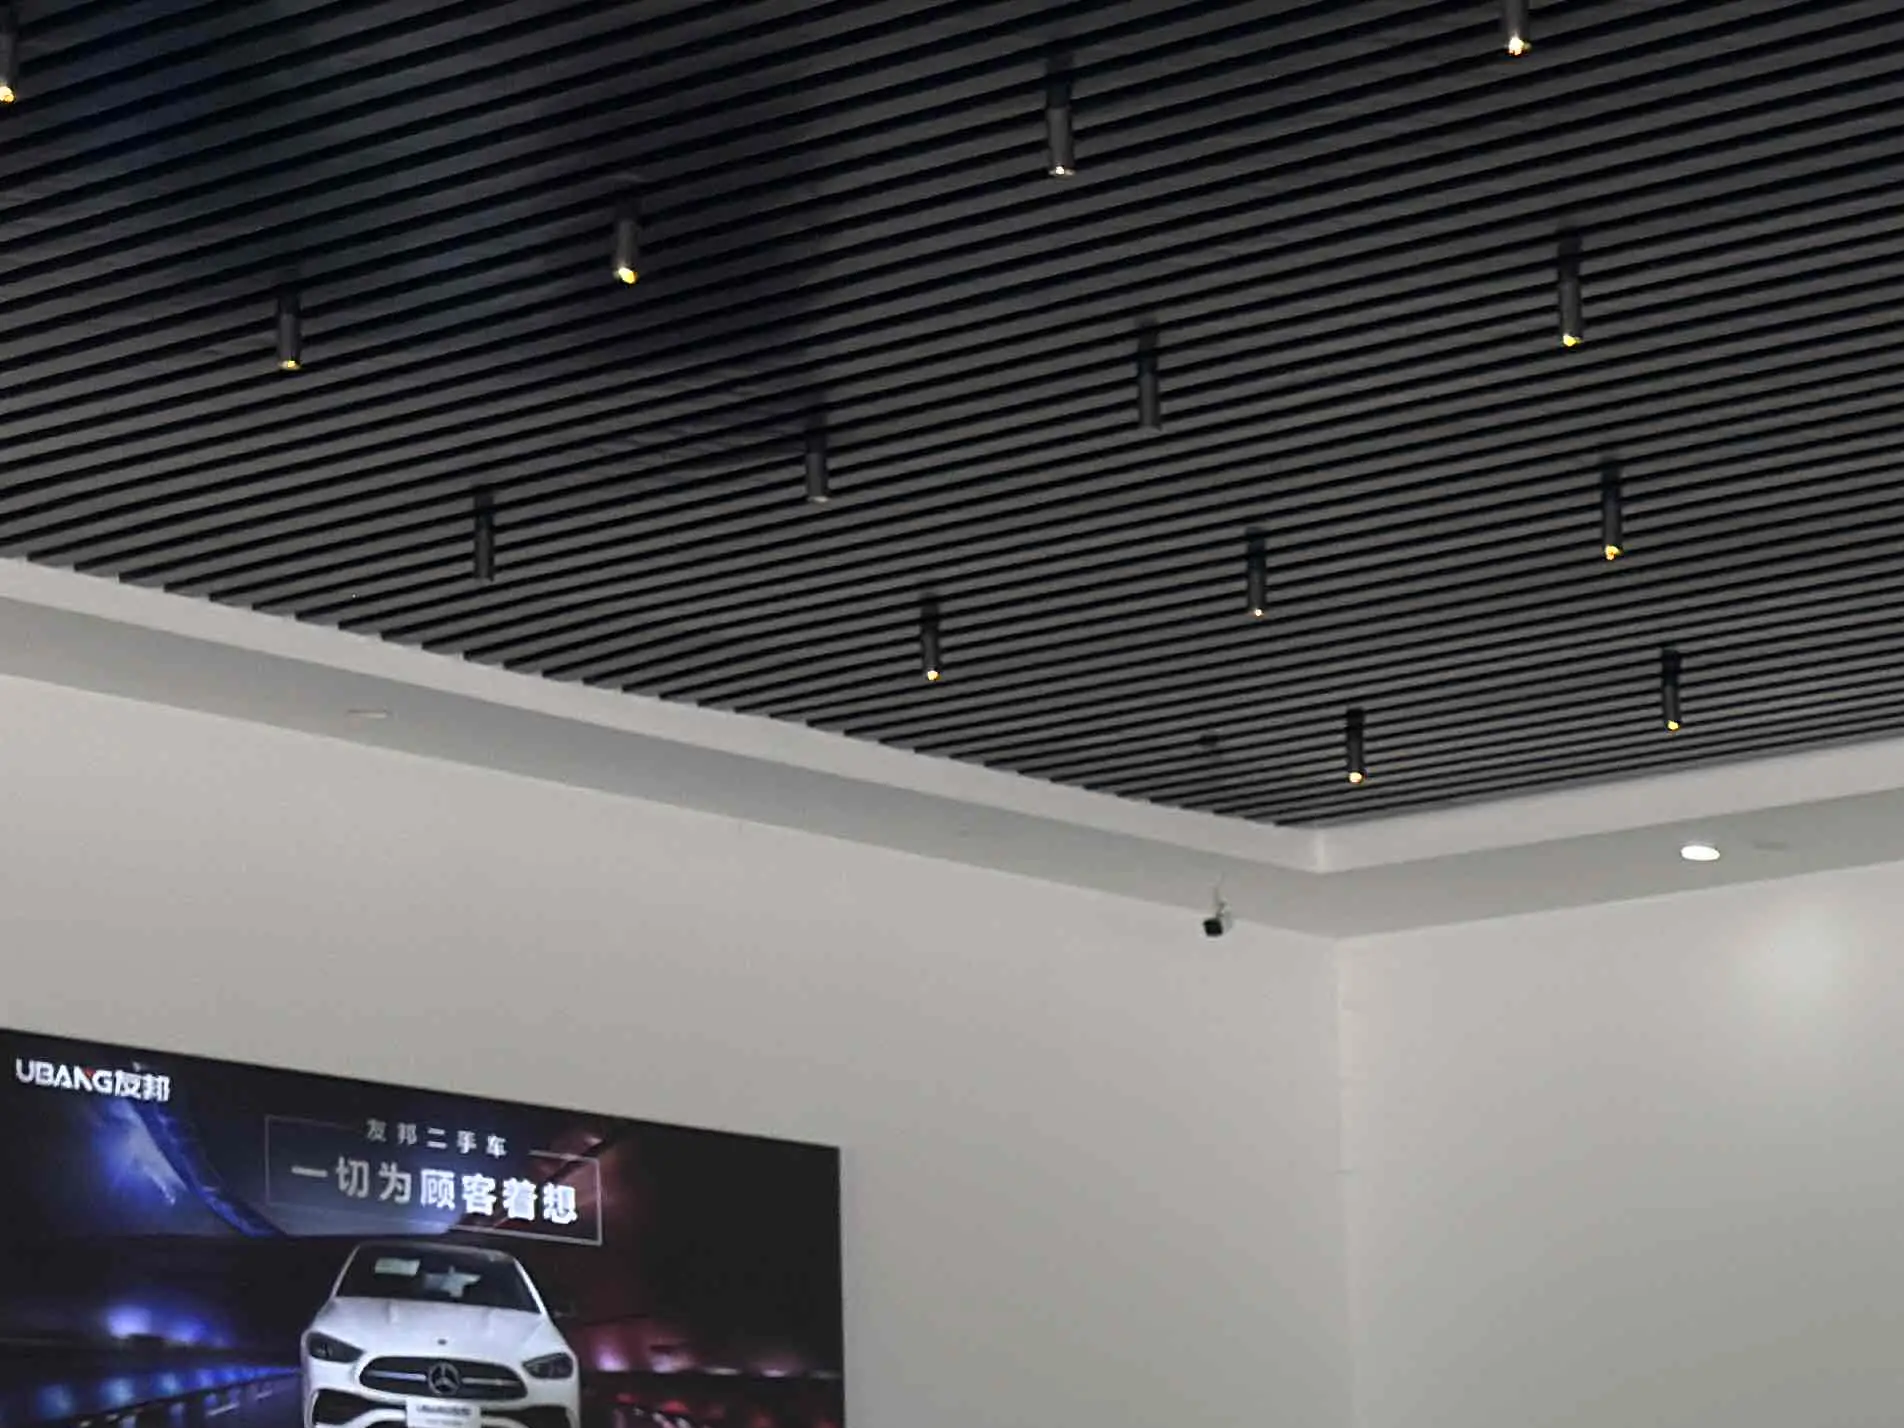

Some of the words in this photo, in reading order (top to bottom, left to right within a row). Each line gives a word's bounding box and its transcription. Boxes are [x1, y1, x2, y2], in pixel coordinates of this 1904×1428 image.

[15, 1057, 171, 1103] UBANG友邦
[365, 1118, 508, 1160] 友邦二手车
[290, 1156, 579, 1225] 一切为顾客着想
